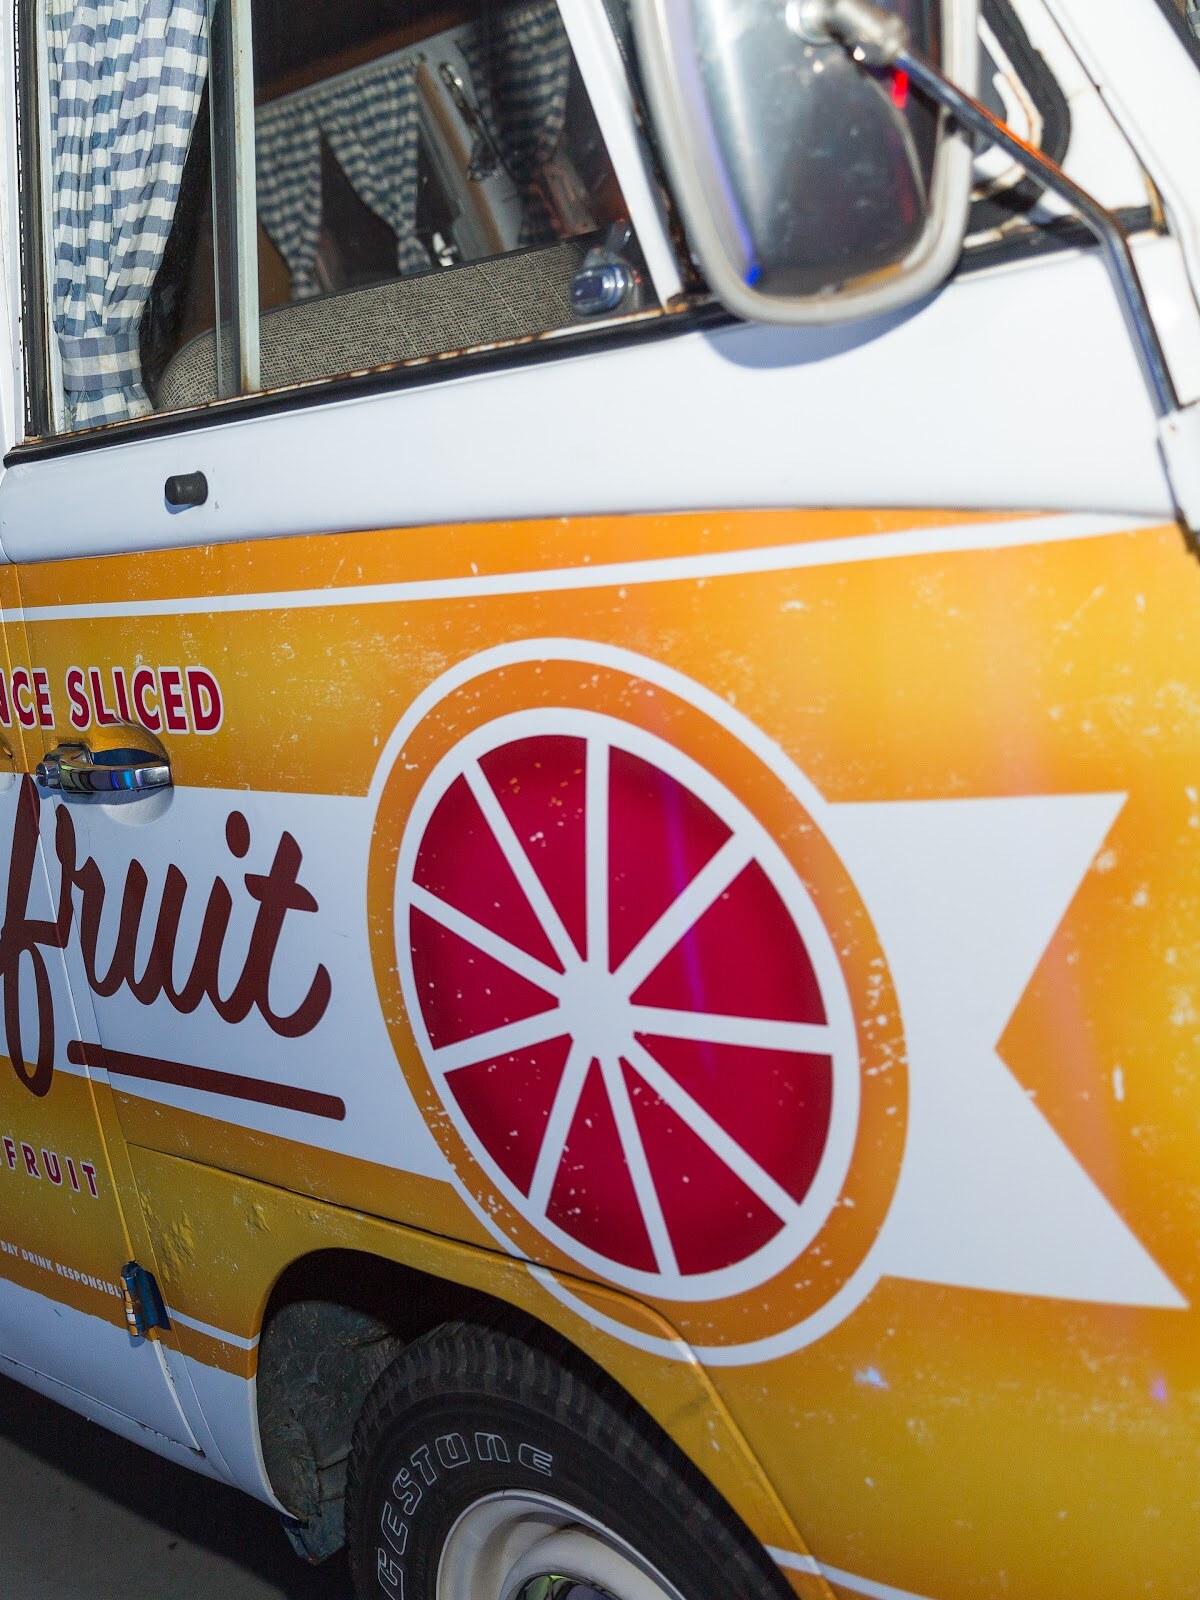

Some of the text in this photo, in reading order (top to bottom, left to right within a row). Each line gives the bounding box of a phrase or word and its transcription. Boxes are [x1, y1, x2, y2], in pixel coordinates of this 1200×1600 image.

[65, 665, 224, 735] SLICED
[0, 1239, 19, 1257] DAY
[21, 1248, 54, 1272] DRINK
